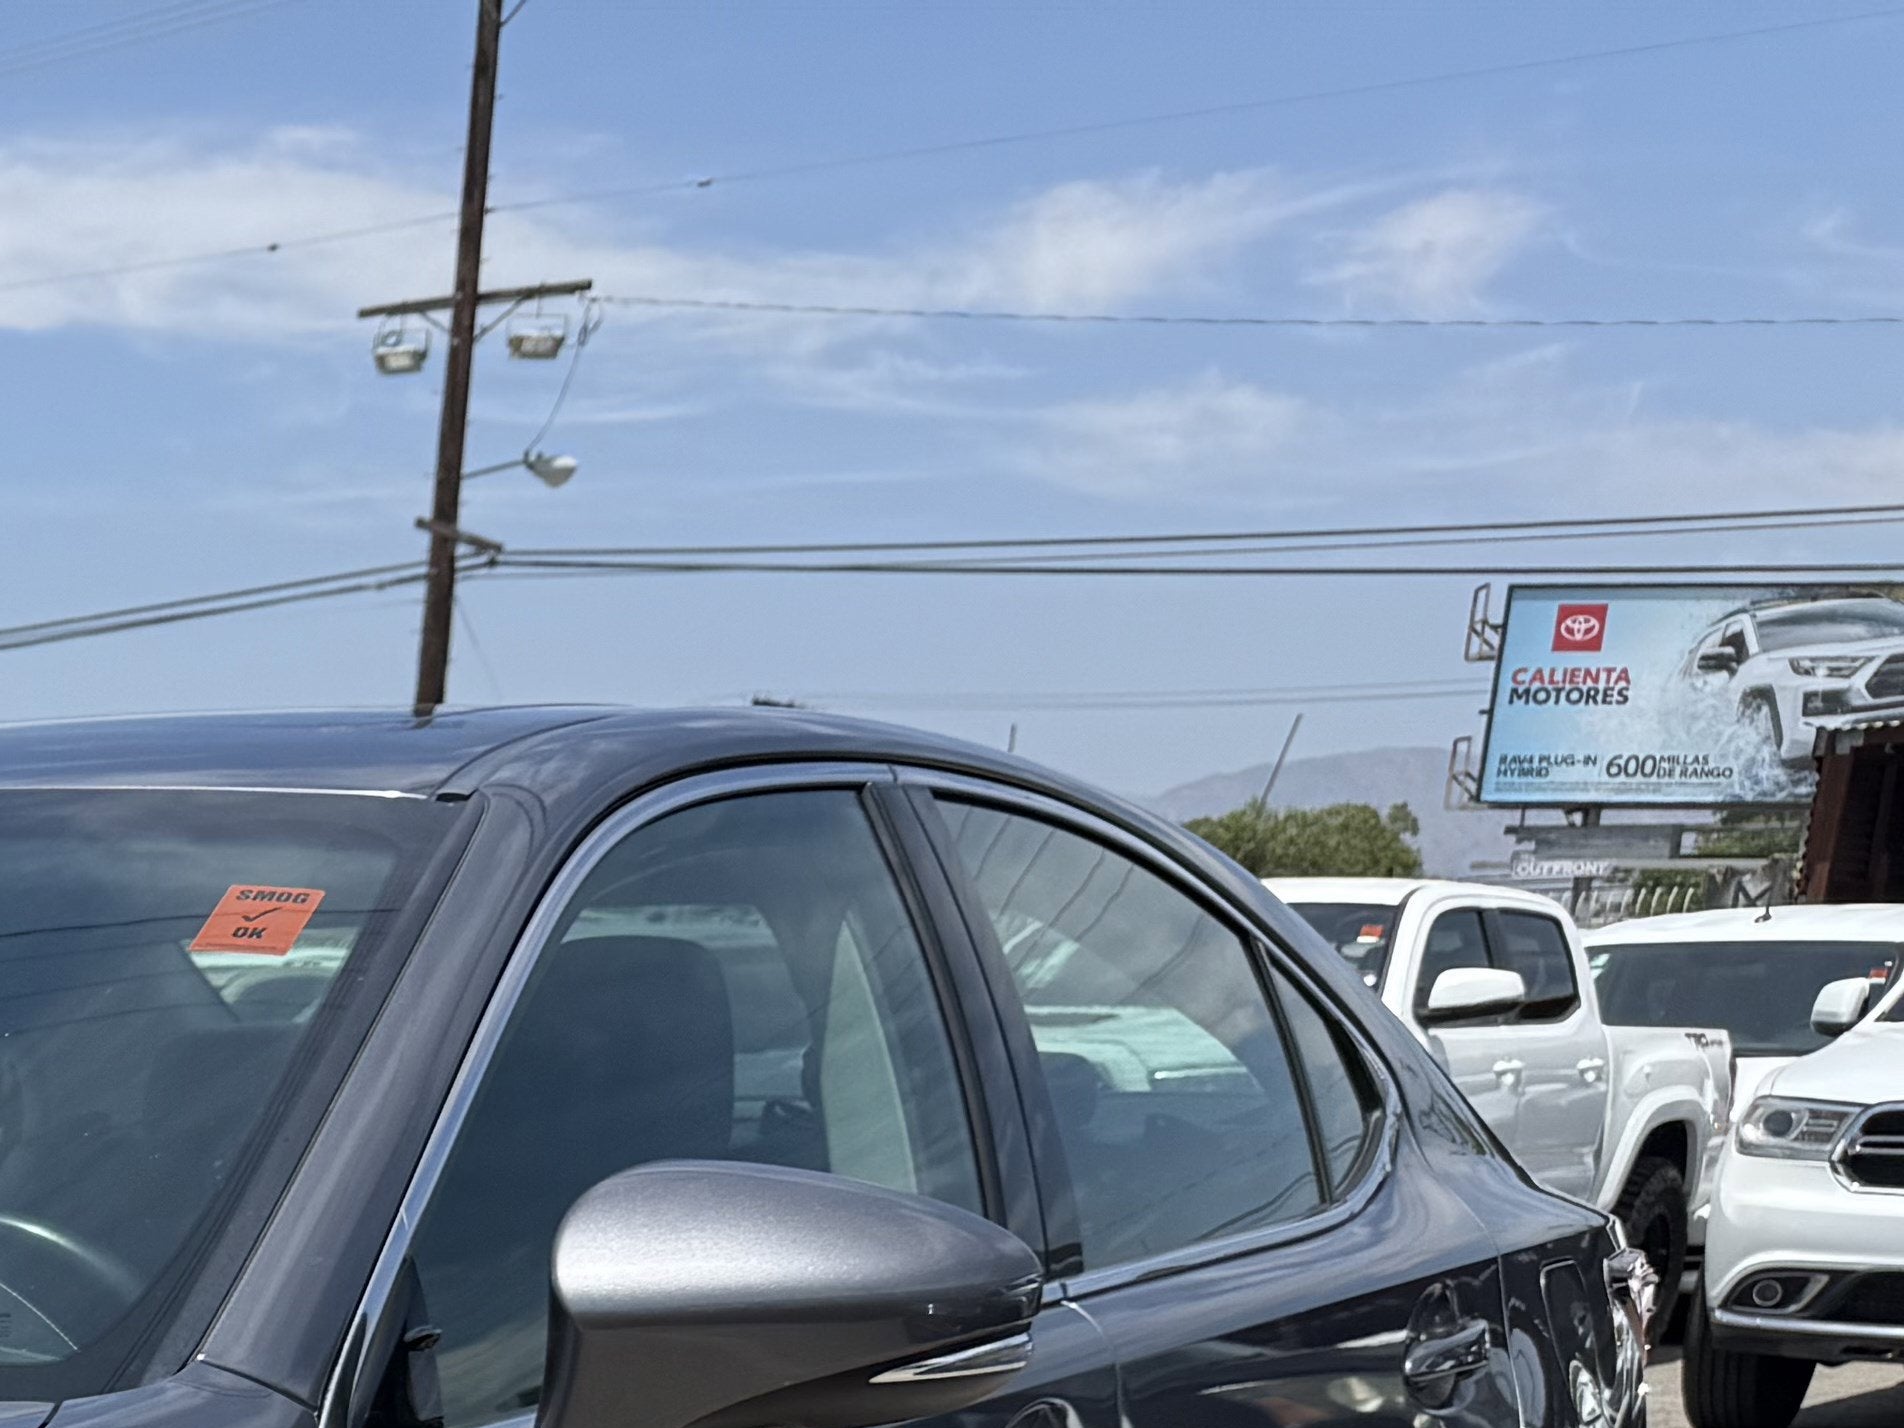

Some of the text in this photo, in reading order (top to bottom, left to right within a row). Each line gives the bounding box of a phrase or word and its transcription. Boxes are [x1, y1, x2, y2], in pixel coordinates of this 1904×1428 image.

[1511, 667, 1631, 686] CALIENTA
[1509, 685, 1630, 706] MOTORES
[1538, 753, 1598, 767] PLUG-IN
[1605, 754, 1657, 778] 600
[1658, 754, 1710, 766] MILLAS
[1496, 766, 1550, 778] HYBRID
[1656, 766, 1734, 779] DE RANGO
[1516, 860, 1610, 878] OUTFRONT
[235, 889, 311, 905] SMOG
[232, 926, 268, 940] OK
